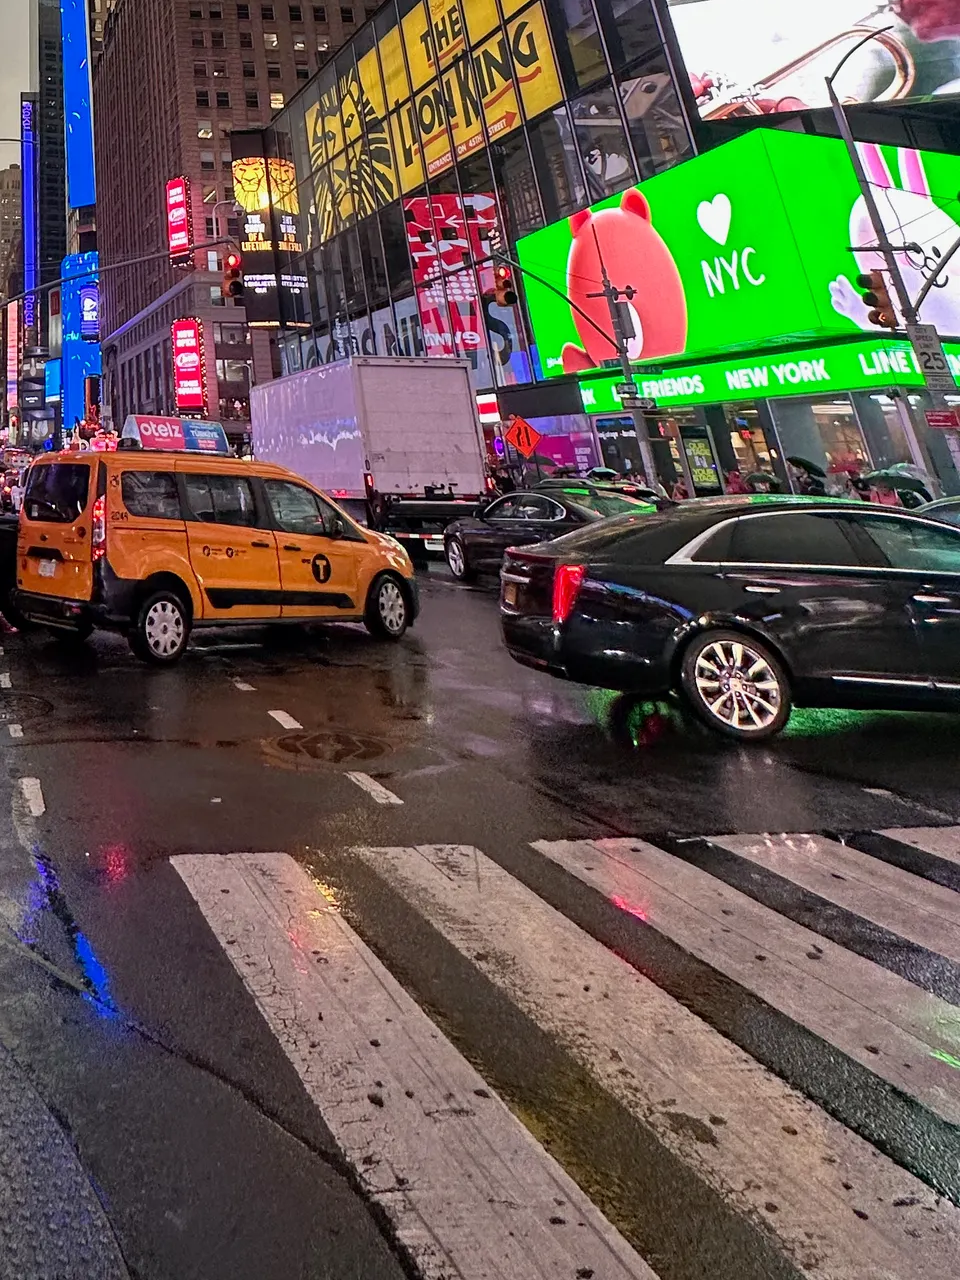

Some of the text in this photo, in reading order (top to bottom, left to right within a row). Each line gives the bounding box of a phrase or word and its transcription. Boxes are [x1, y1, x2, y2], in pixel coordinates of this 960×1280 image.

[420, 5, 463, 63] THE
[395, 21, 540, 168] LION KING
[488, 120, 507, 136] STREET
[241, 241, 272, 252] LIFETIME
[248, 233, 263, 242] OF A
[700, 246, 766, 298] NYC
[920, 352, 945, 370] 25
[642, 374, 704, 398] FRIENDS
[725, 365, 769, 390] NEW
[771, 358, 830, 385] YORK
[858, 350, 911, 375] LINE
[140, 421, 182, 438] otelz
